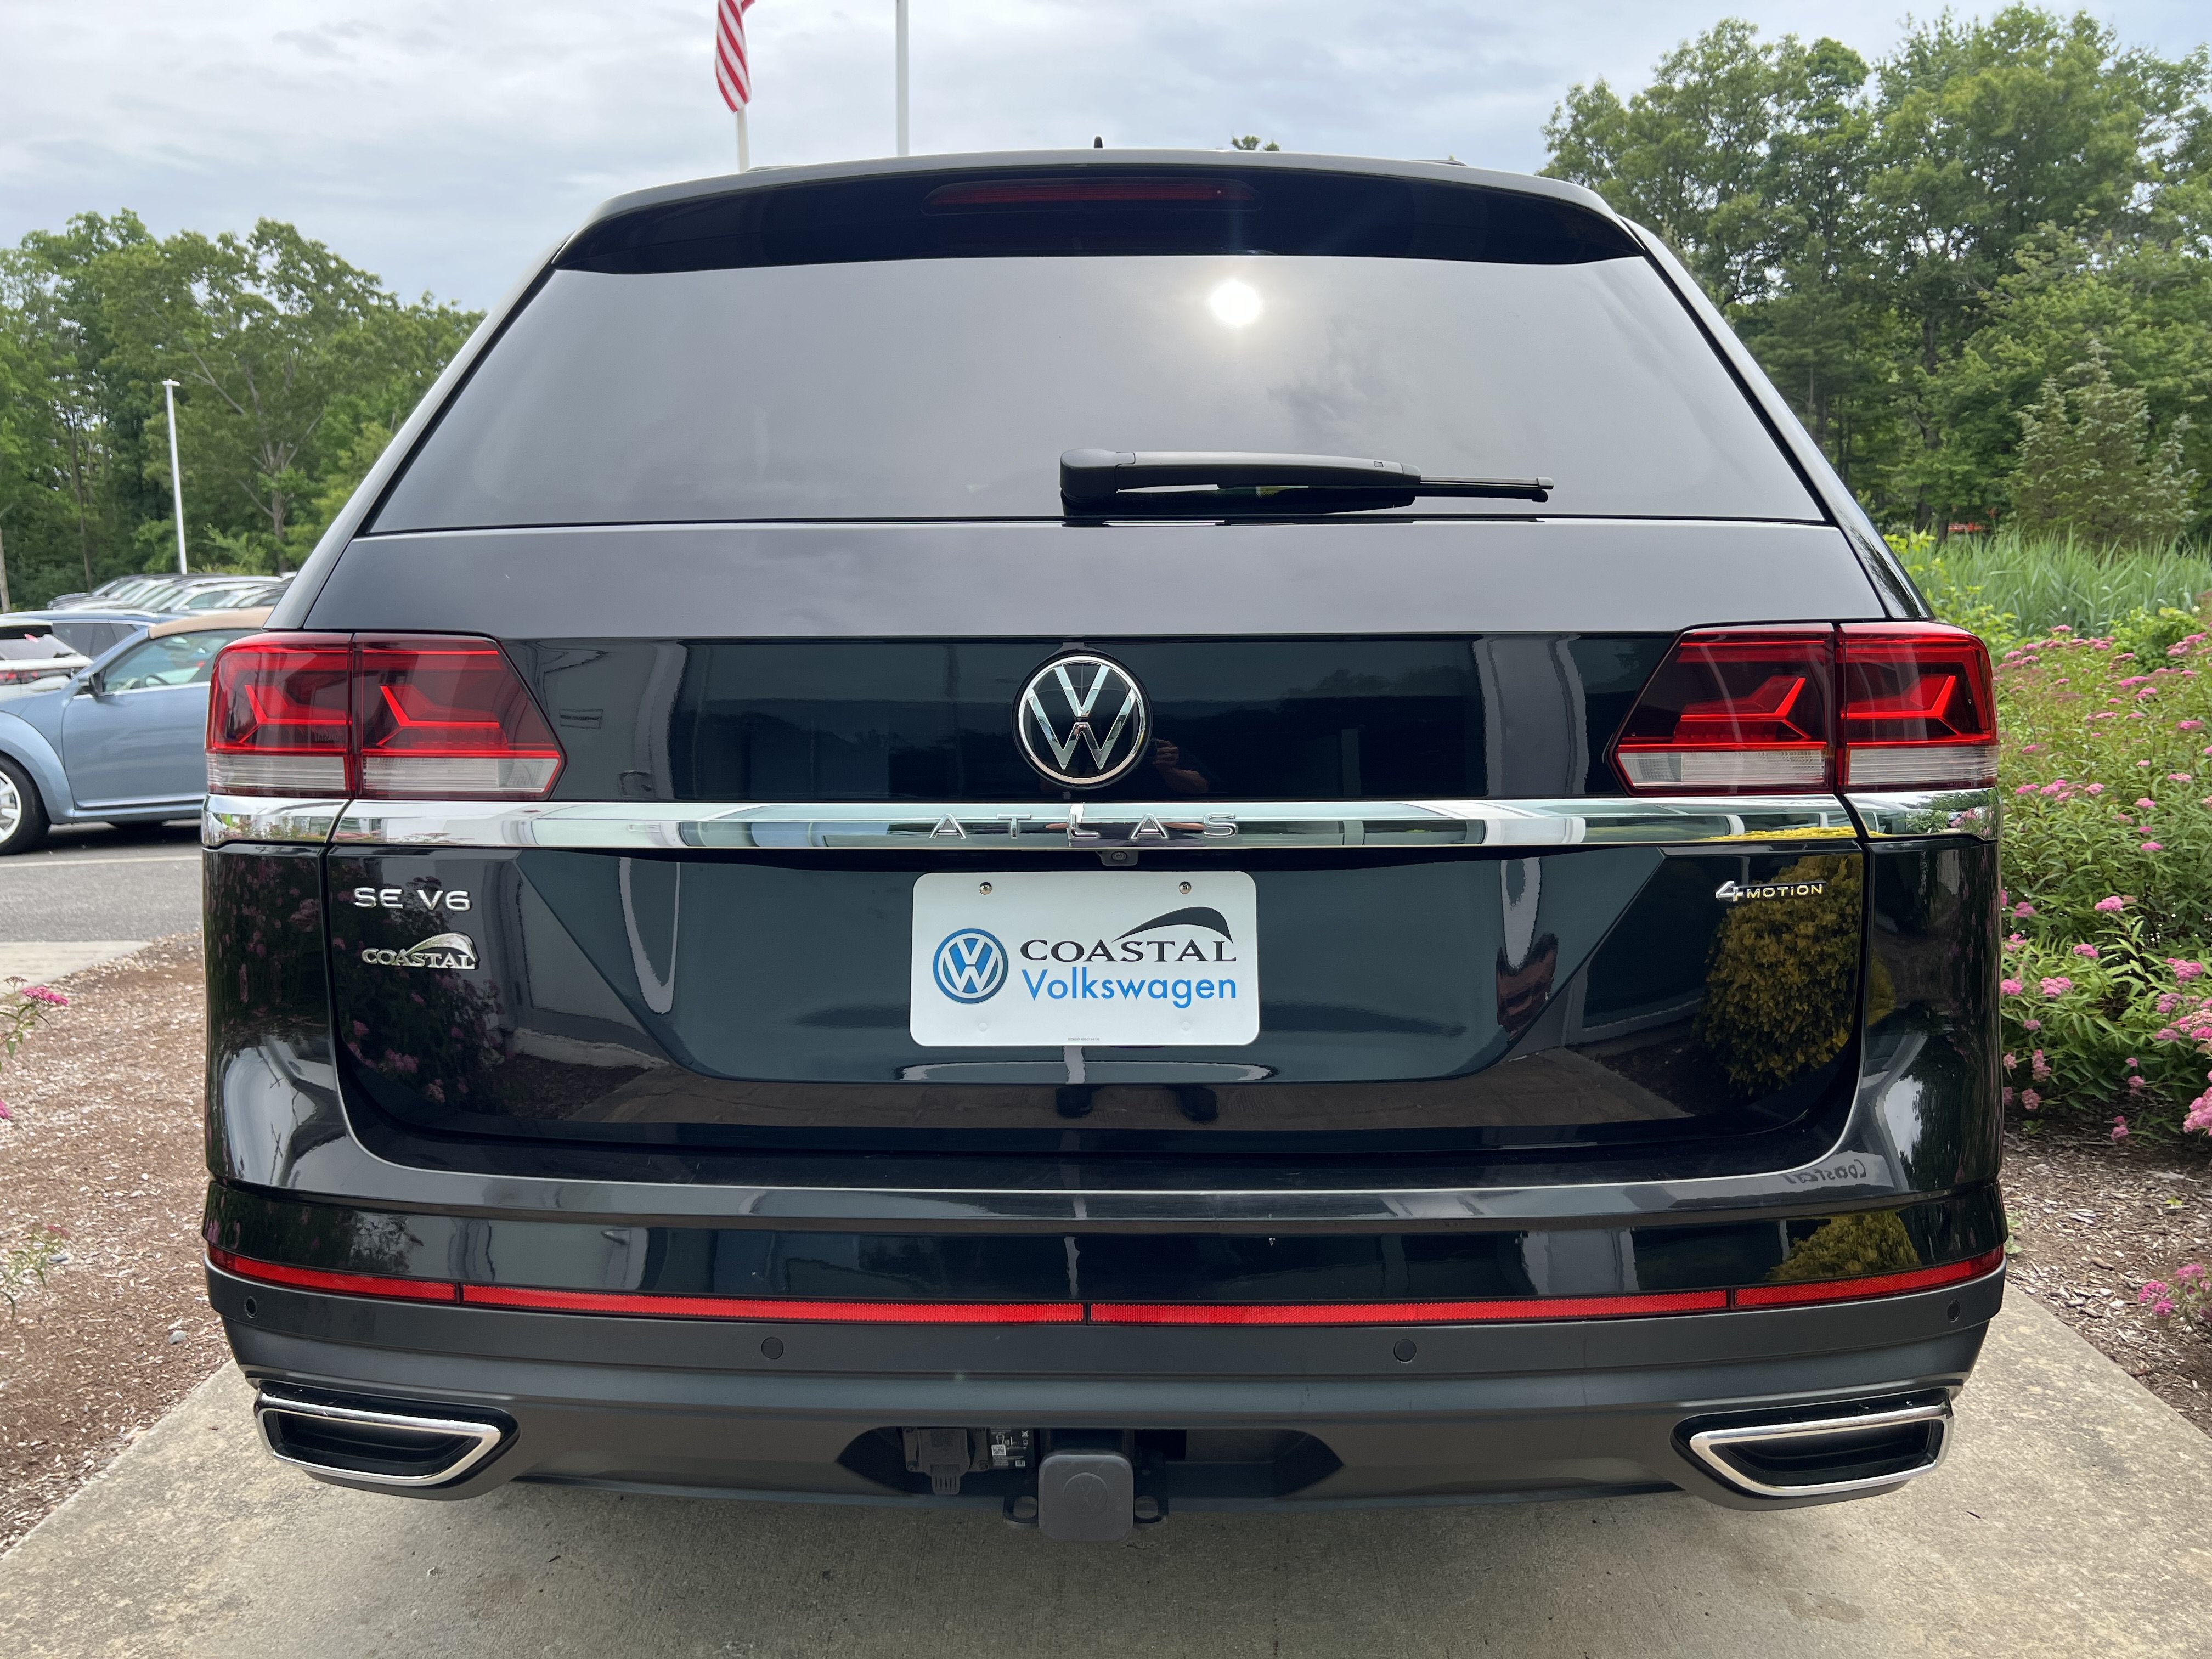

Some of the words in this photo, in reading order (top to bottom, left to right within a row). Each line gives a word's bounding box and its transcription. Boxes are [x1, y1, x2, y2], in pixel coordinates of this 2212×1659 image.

[1026, 661, 1140, 771] VW
[929, 813, 1238, 839] ATLAS
[353, 887, 403, 909] SE
[416, 889, 472, 911] V6
[362, 947, 476, 969] COASTAL
[1020, 939, 1237, 963] COASTAL
[1021, 967, 1237, 1009] Volkswagen
